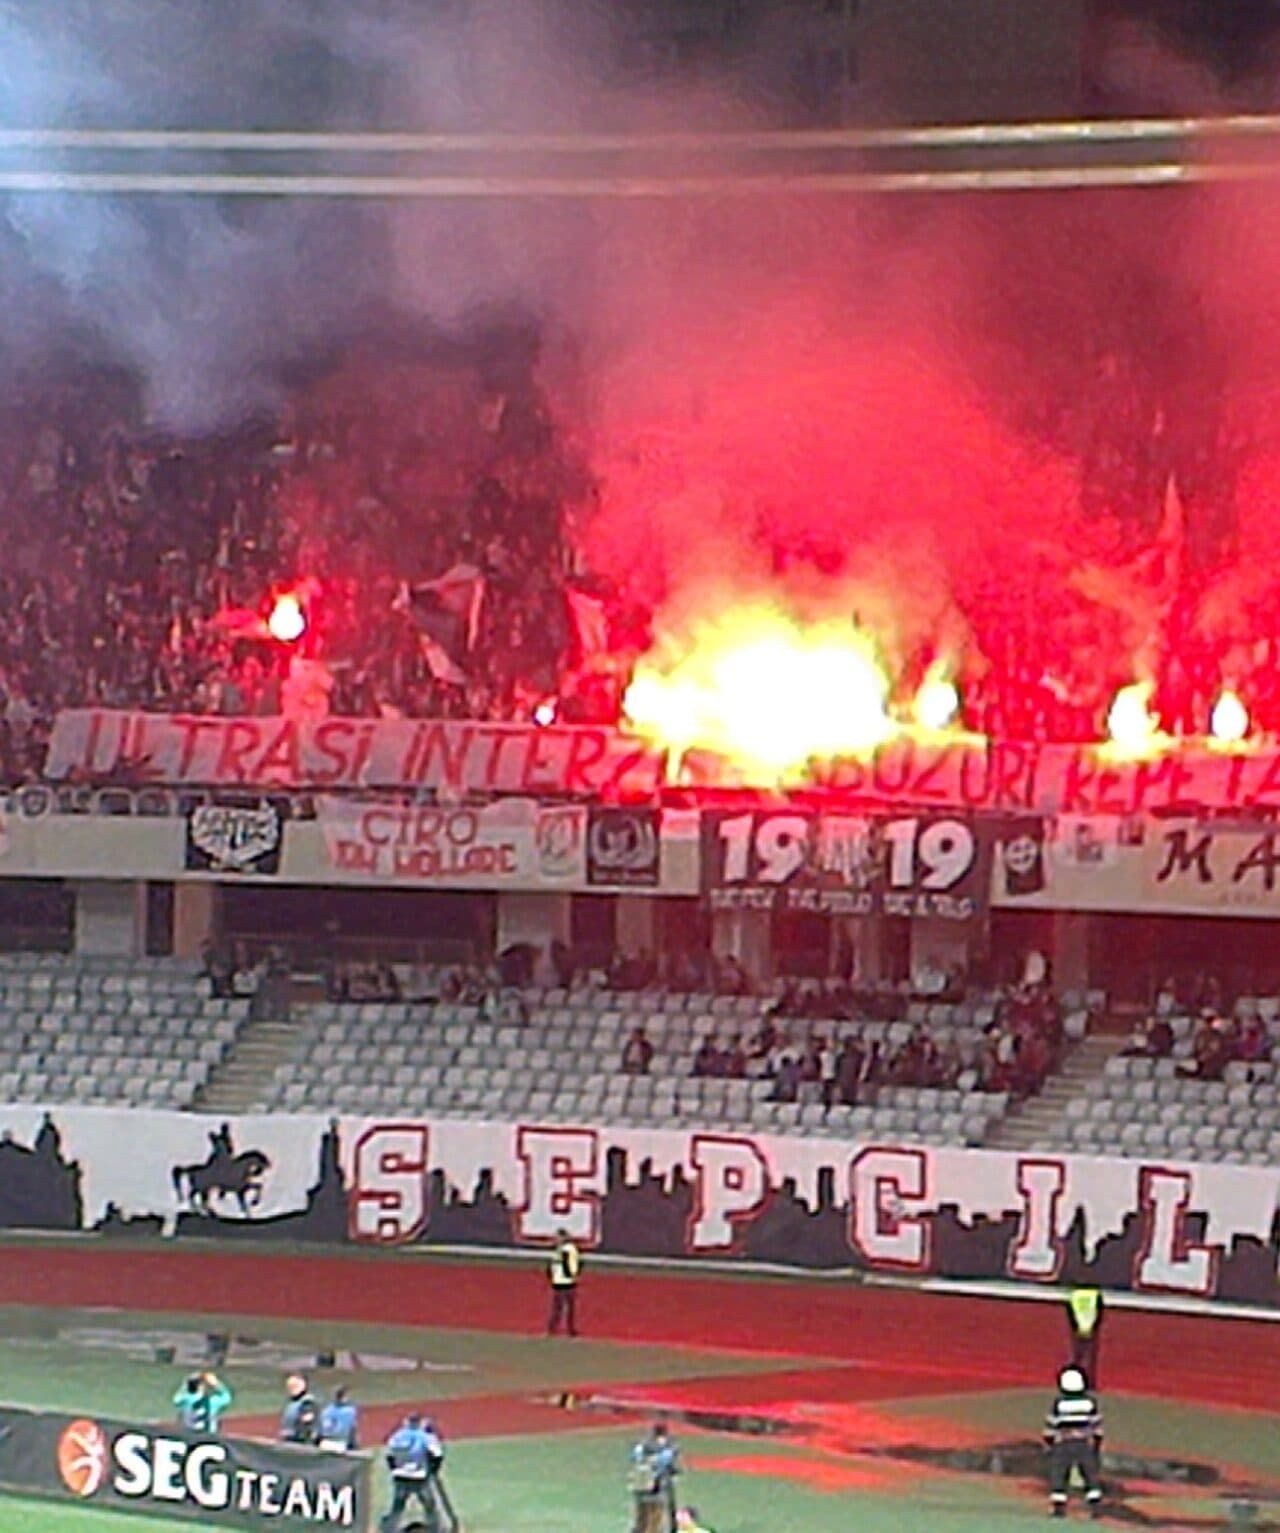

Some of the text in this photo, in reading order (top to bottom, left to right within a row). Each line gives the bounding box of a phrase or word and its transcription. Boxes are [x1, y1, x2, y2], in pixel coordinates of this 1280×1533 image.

[361, 809, 479, 847] CIRO
[718, 813, 975, 891] 19 19
[112, 1432, 356, 1527] SEG TEAM
